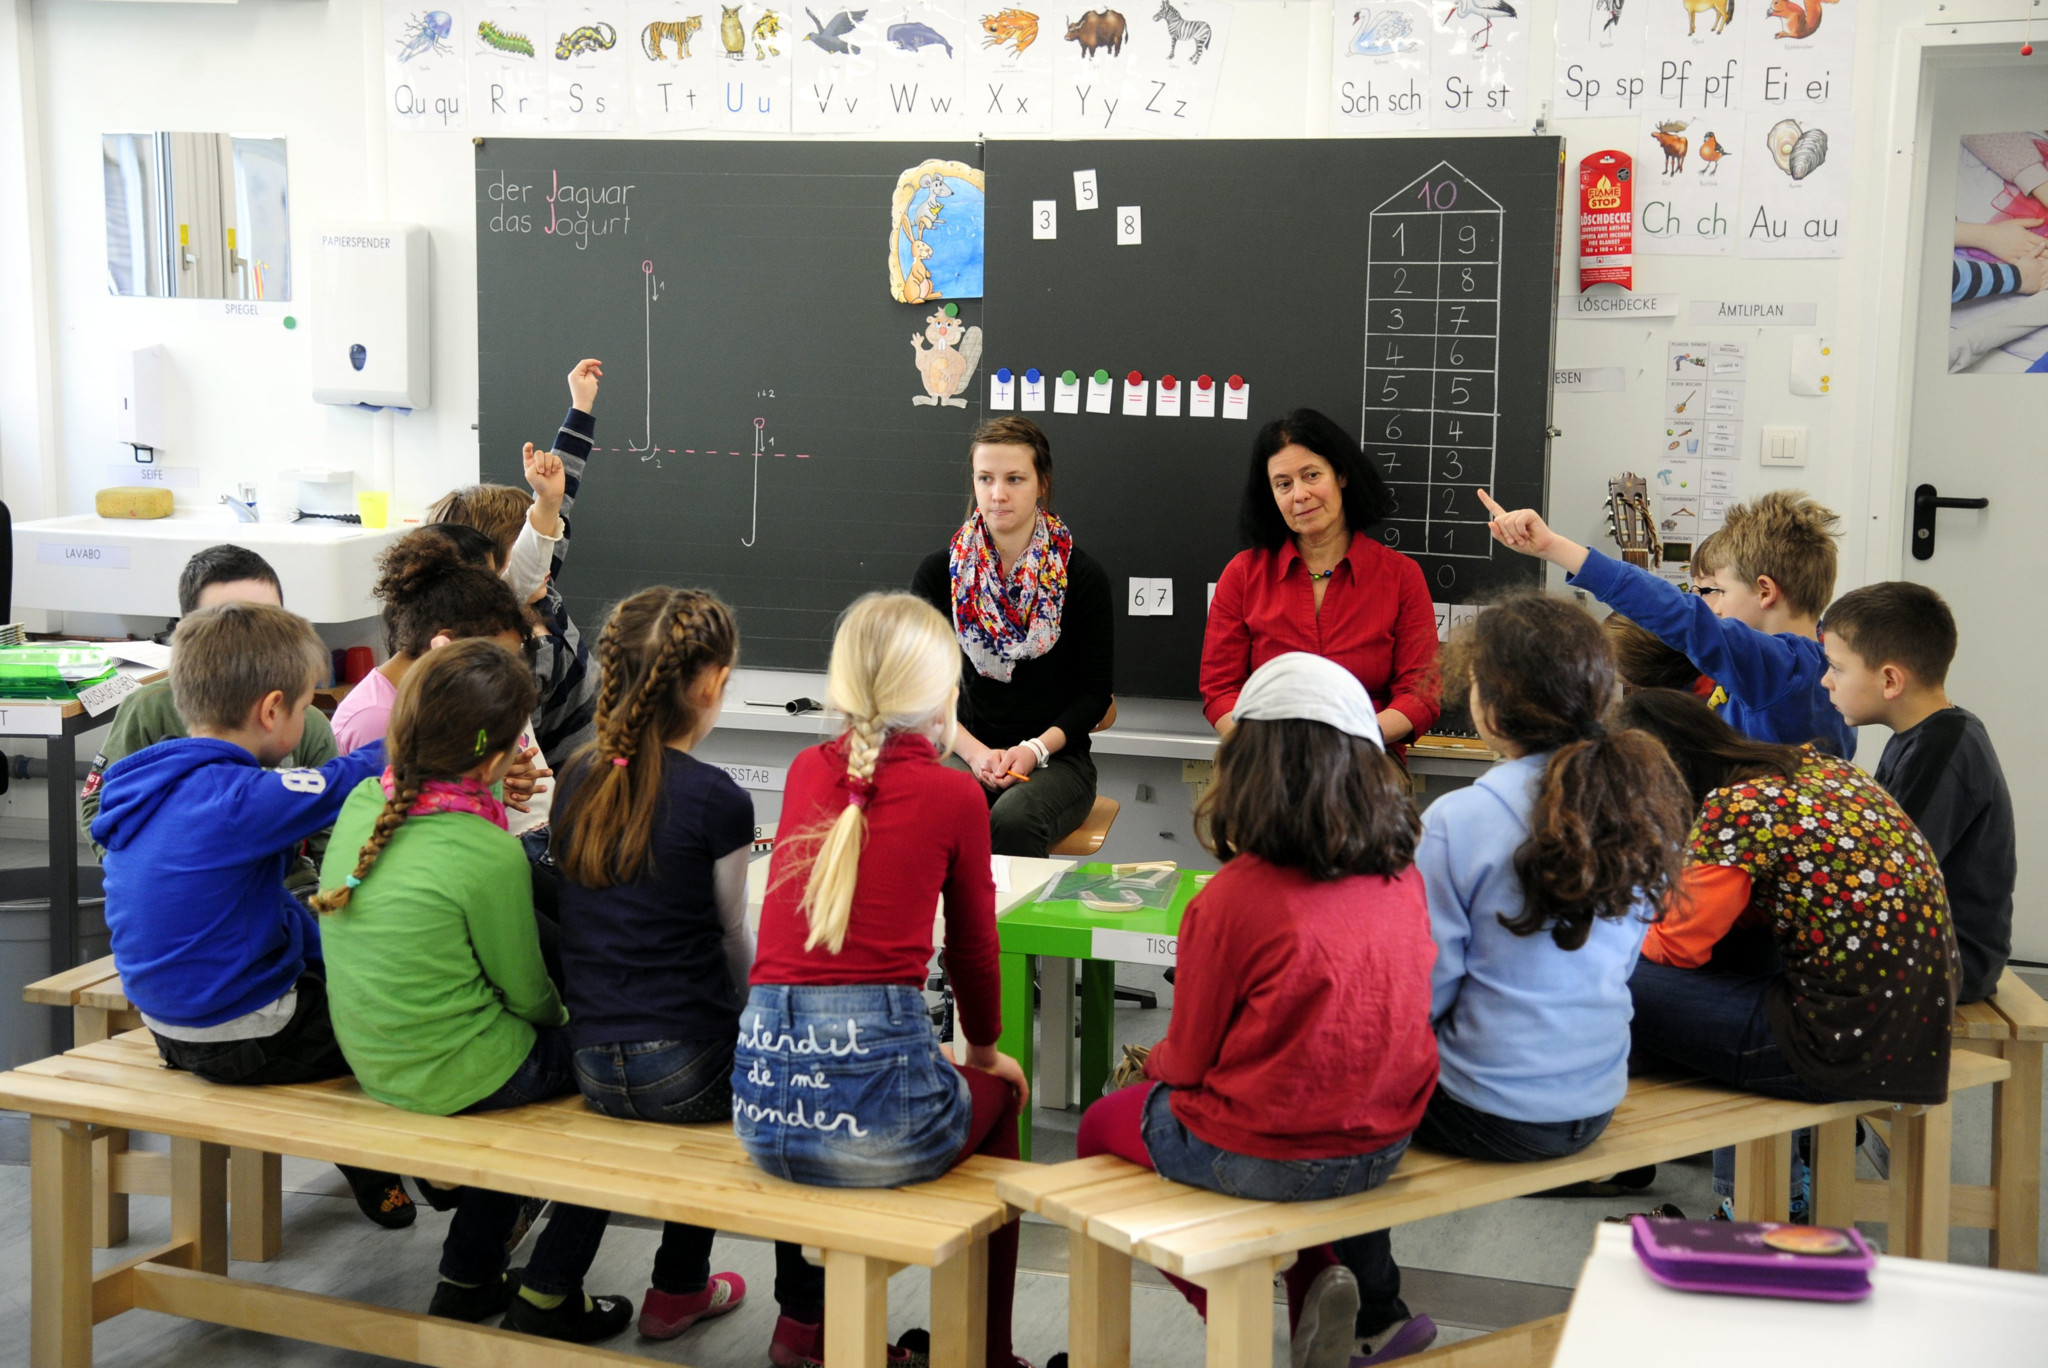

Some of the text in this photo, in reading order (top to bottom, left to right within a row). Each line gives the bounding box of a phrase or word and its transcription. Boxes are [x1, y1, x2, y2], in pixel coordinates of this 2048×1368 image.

[1341, 78, 1421, 113] Sch sch
[1445, 76, 1510, 108] St st
[1566, 64, 1644, 111] Sp sp
[1660, 59, 1737, 108] Pf pf
[1764, 66, 1829, 100] Ei ei
[395, 84, 458, 126] Qu qu
[491, 84, 528, 114] R r
[569, 83, 605, 113] S s
[657, 83, 696, 112] T t
[727, 82, 770, 113] U u
[814, 84, 858, 113] V v
[890, 83, 952, 113] W w
[988, 83, 1028, 113] X x
[1076, 85, 1118, 128] Y y
[1145, 80, 1187, 118] Z z
[488, 169, 635, 219] der Jaguar
[1082, 181, 1094, 200] 5
[1418, 180, 1457, 210] 10
[1589, 187, 1620, 197] FLAME
[1592, 198, 1617, 207] STOP
[490, 203, 630, 250] das Jogurt
[1040, 210, 1050, 230] 3
[1124, 215, 1135, 235] 8
[1581, 212, 1631, 225] LÖSCHDECKE
[1642, 201, 1727, 234] Ch ch
[1750, 205, 1838, 238] Au au
[322, 236, 390, 249] PAPIERSPENDER
[1392, 223, 1476, 256] 1 9
[1394, 268, 1474, 293] 2 8
[225, 303, 259, 316] SPIEGEL
[1577, 297, 1657, 312] LÖSCHDECKE
[1387, 306, 1469, 334] 3 7
[1386, 339, 1463, 366] 4 6
[1381, 376, 1472, 404] 5 5
[1555, 372, 1582, 384] ESEN
[1386, 414, 1463, 442] 6 4
[141, 469, 163, 480] SEIFE
[1378, 451, 1463, 479] 7 3
[1443, 488, 1459, 514] 2
[1384, 528, 1453, 549] 9 1
[65, 547, 101, 560] LAVABO
[1134, 587, 1167, 607] 6 7
[718, 766, 769, 783] SSTAB
[737, 1014, 870, 1057] nterdit
